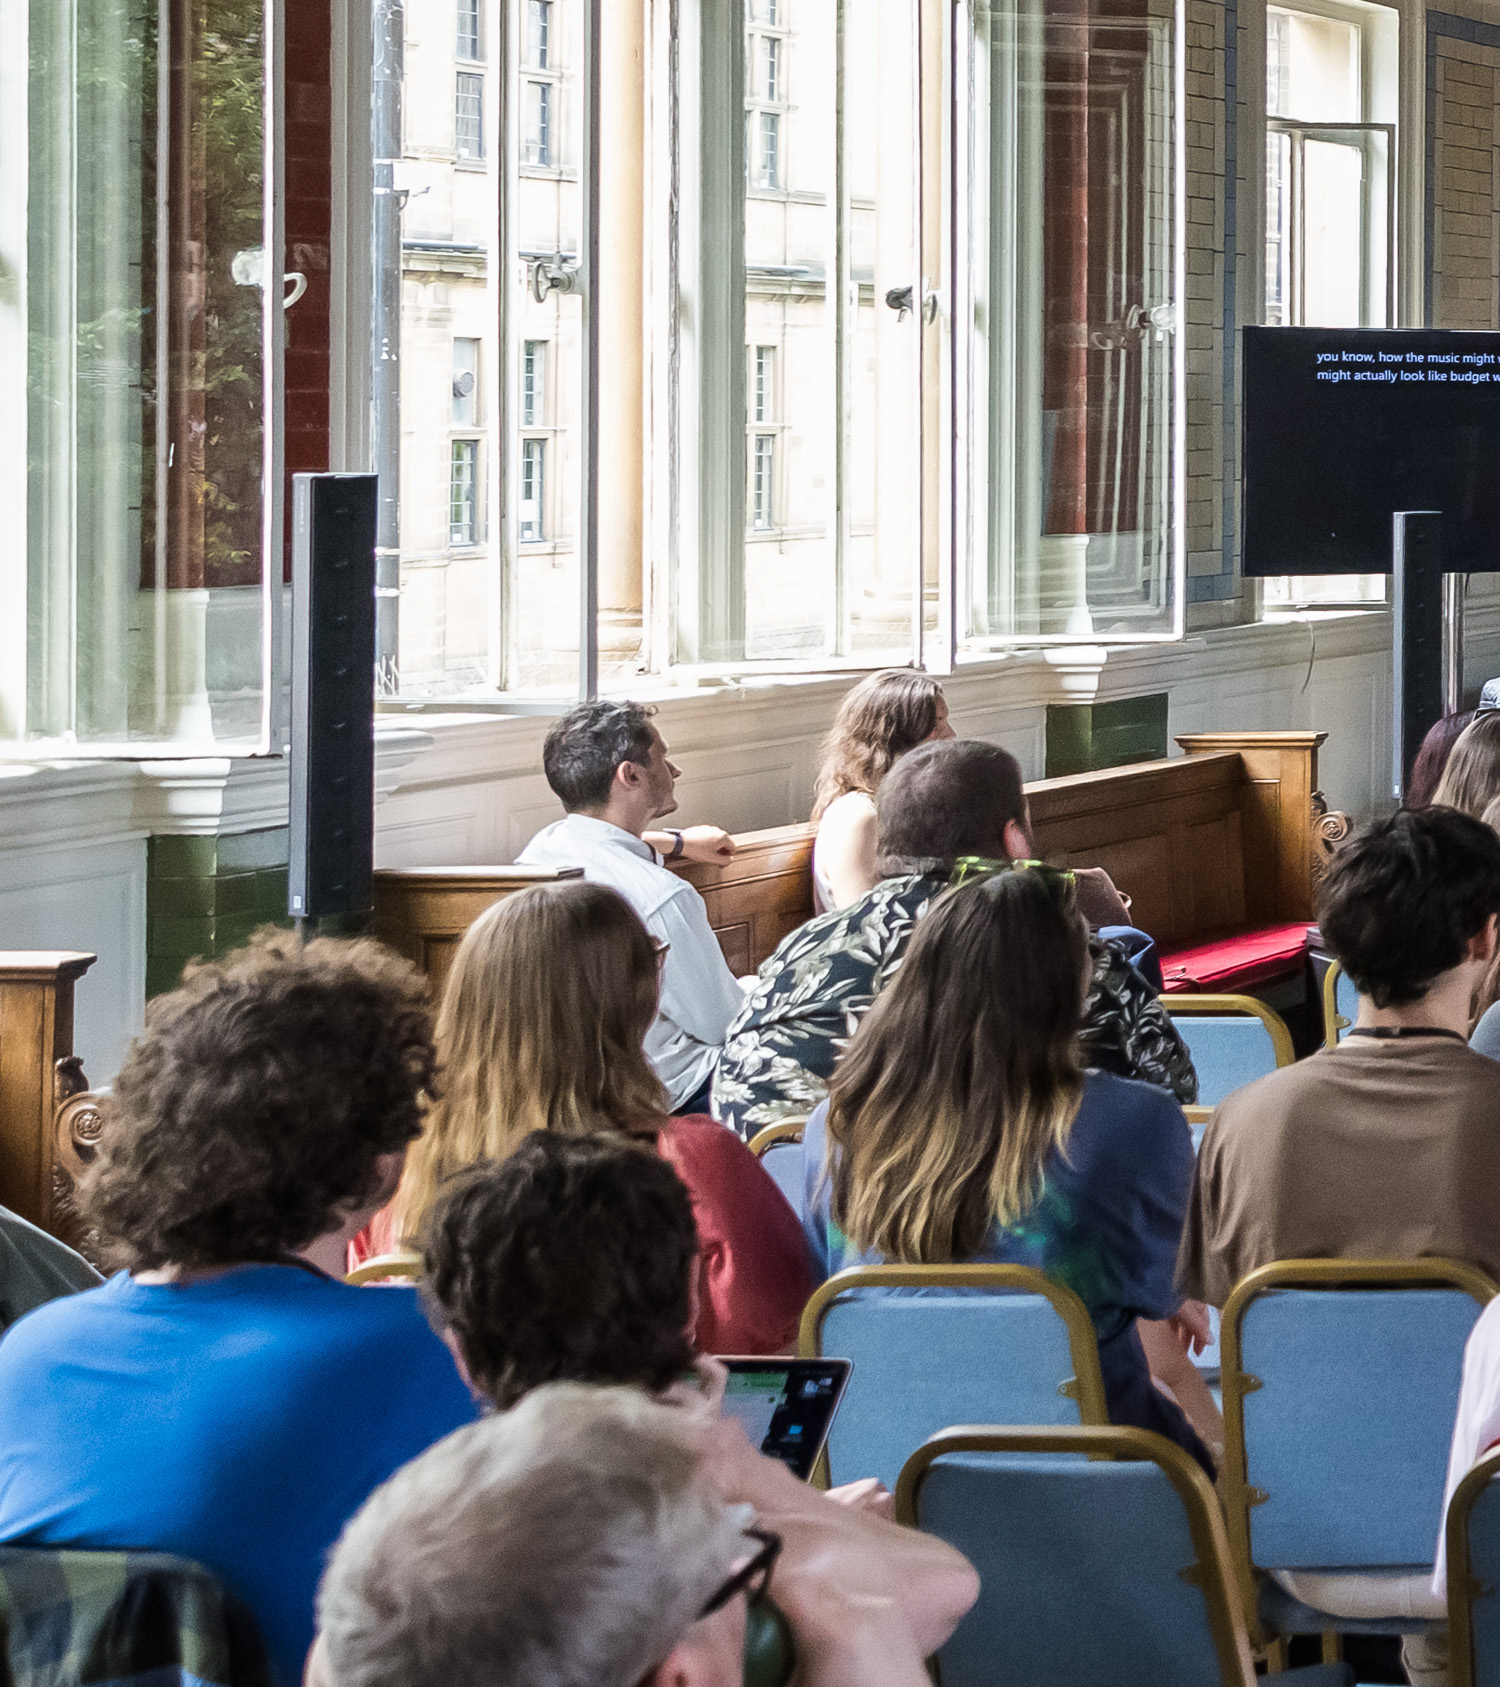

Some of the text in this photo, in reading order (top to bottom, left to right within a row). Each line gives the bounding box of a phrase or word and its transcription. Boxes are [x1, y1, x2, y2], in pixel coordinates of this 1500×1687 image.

[1316, 353, 1338, 364] you
[1341, 350, 1375, 363] know,
[1378, 351, 1403, 362] how
[1405, 351, 1424, 363] the
[1427, 352, 1460, 363] music
[1462, 352, 1495, 366] might
[1316, 369, 1351, 383] might
[1353, 369, 1397, 383] actually
[1400, 369, 1425, 381] look
[1427, 370, 1447, 381] like
[1450, 370, 1490, 384] budget
